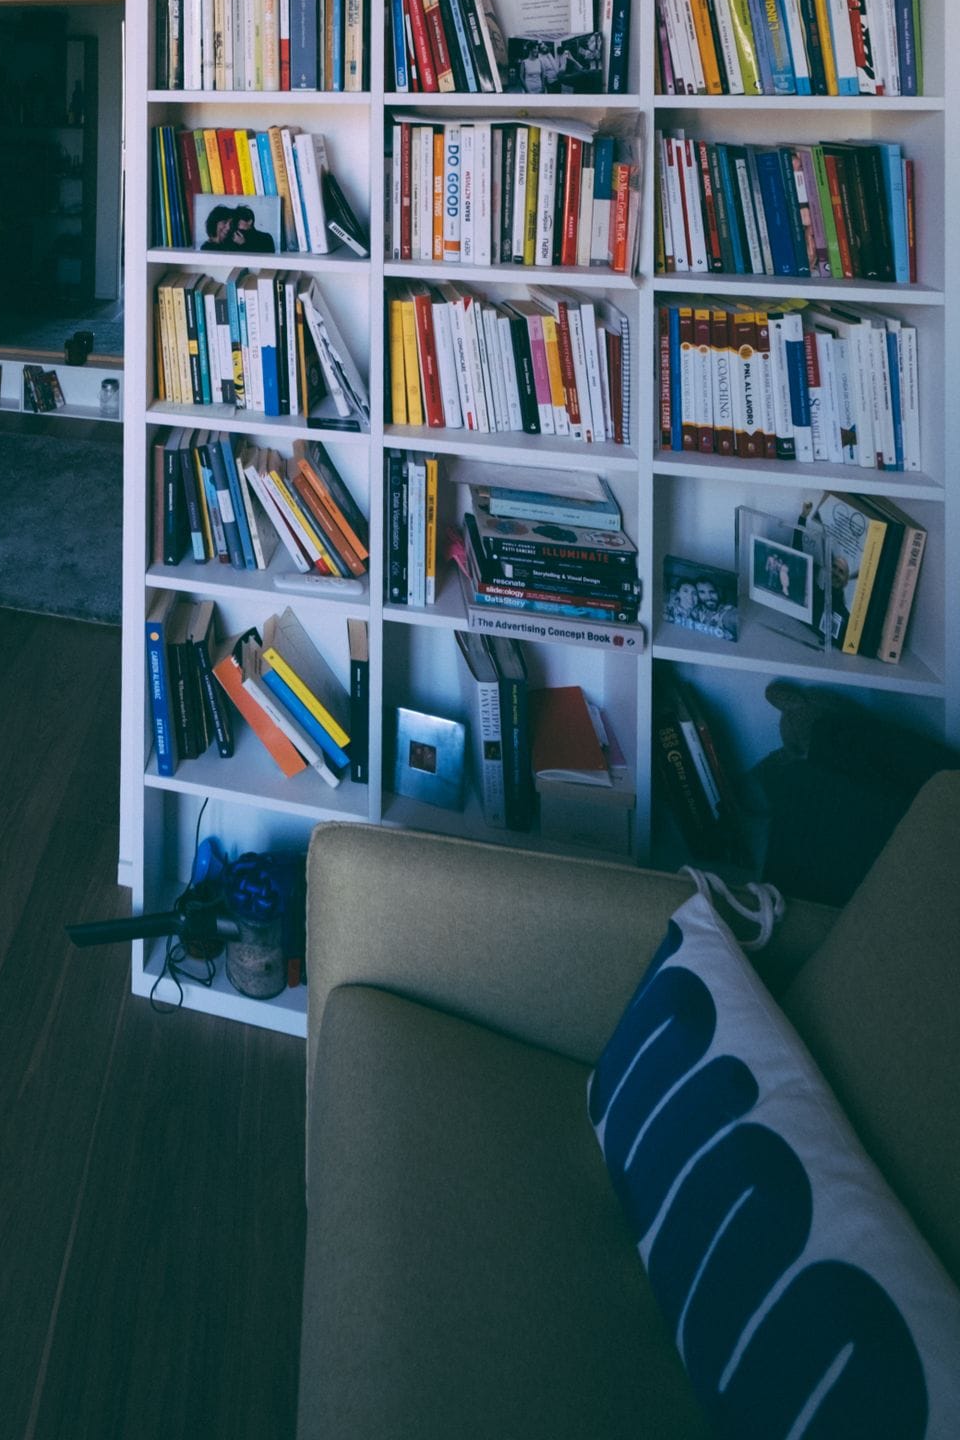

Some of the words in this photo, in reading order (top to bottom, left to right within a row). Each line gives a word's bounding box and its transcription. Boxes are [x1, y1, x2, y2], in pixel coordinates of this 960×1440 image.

[447, 144, 459, 166] DO
[619, 170, 628, 181] Do
[699, 146, 709, 169] POTERE
[704, 175, 713, 197] AMORE
[447, 172, 459, 217] GOOD
[464, 171, 472, 199] ACTIVISM
[619, 182, 628, 200] More
[464, 200, 472, 222] BRAND
[618, 201, 627, 221] Great
[560, 304, 569, 330] crucial
[457, 337, 467, 372] COMUNICARE
[661, 336, 669, 349] THE
[562, 332, 574, 380] conversations
[661, 351, 670, 401] LONG-DISTANCE
[743, 363, 751, 379] PNL
[717, 358, 730, 419] COACHING
[744, 381, 752, 392] AL
[662, 403, 670, 429] LEADER
[745, 394, 754, 425] LAVORO
[542, 546, 609, 564] ILLUMINATE
[493, 577, 526, 588] resonate
[532, 569, 561, 581] Storytelling
[567, 574, 583, 583] Visual
[583, 576, 601, 586] Design
[485, 586, 524, 600] slide:ology
[478, 617, 495, 629] The
[496, 619, 546, 637] Advertising
[547, 626, 586, 641] Concept
[587, 631, 611, 644] Book
[151, 651, 159, 673] CARBON
[153, 673, 162, 700] ALMANAC
[481, 688, 492, 737] DAVERIO
[490, 688, 501, 737] PHILIPPE
[156, 718, 164, 734] SETH
